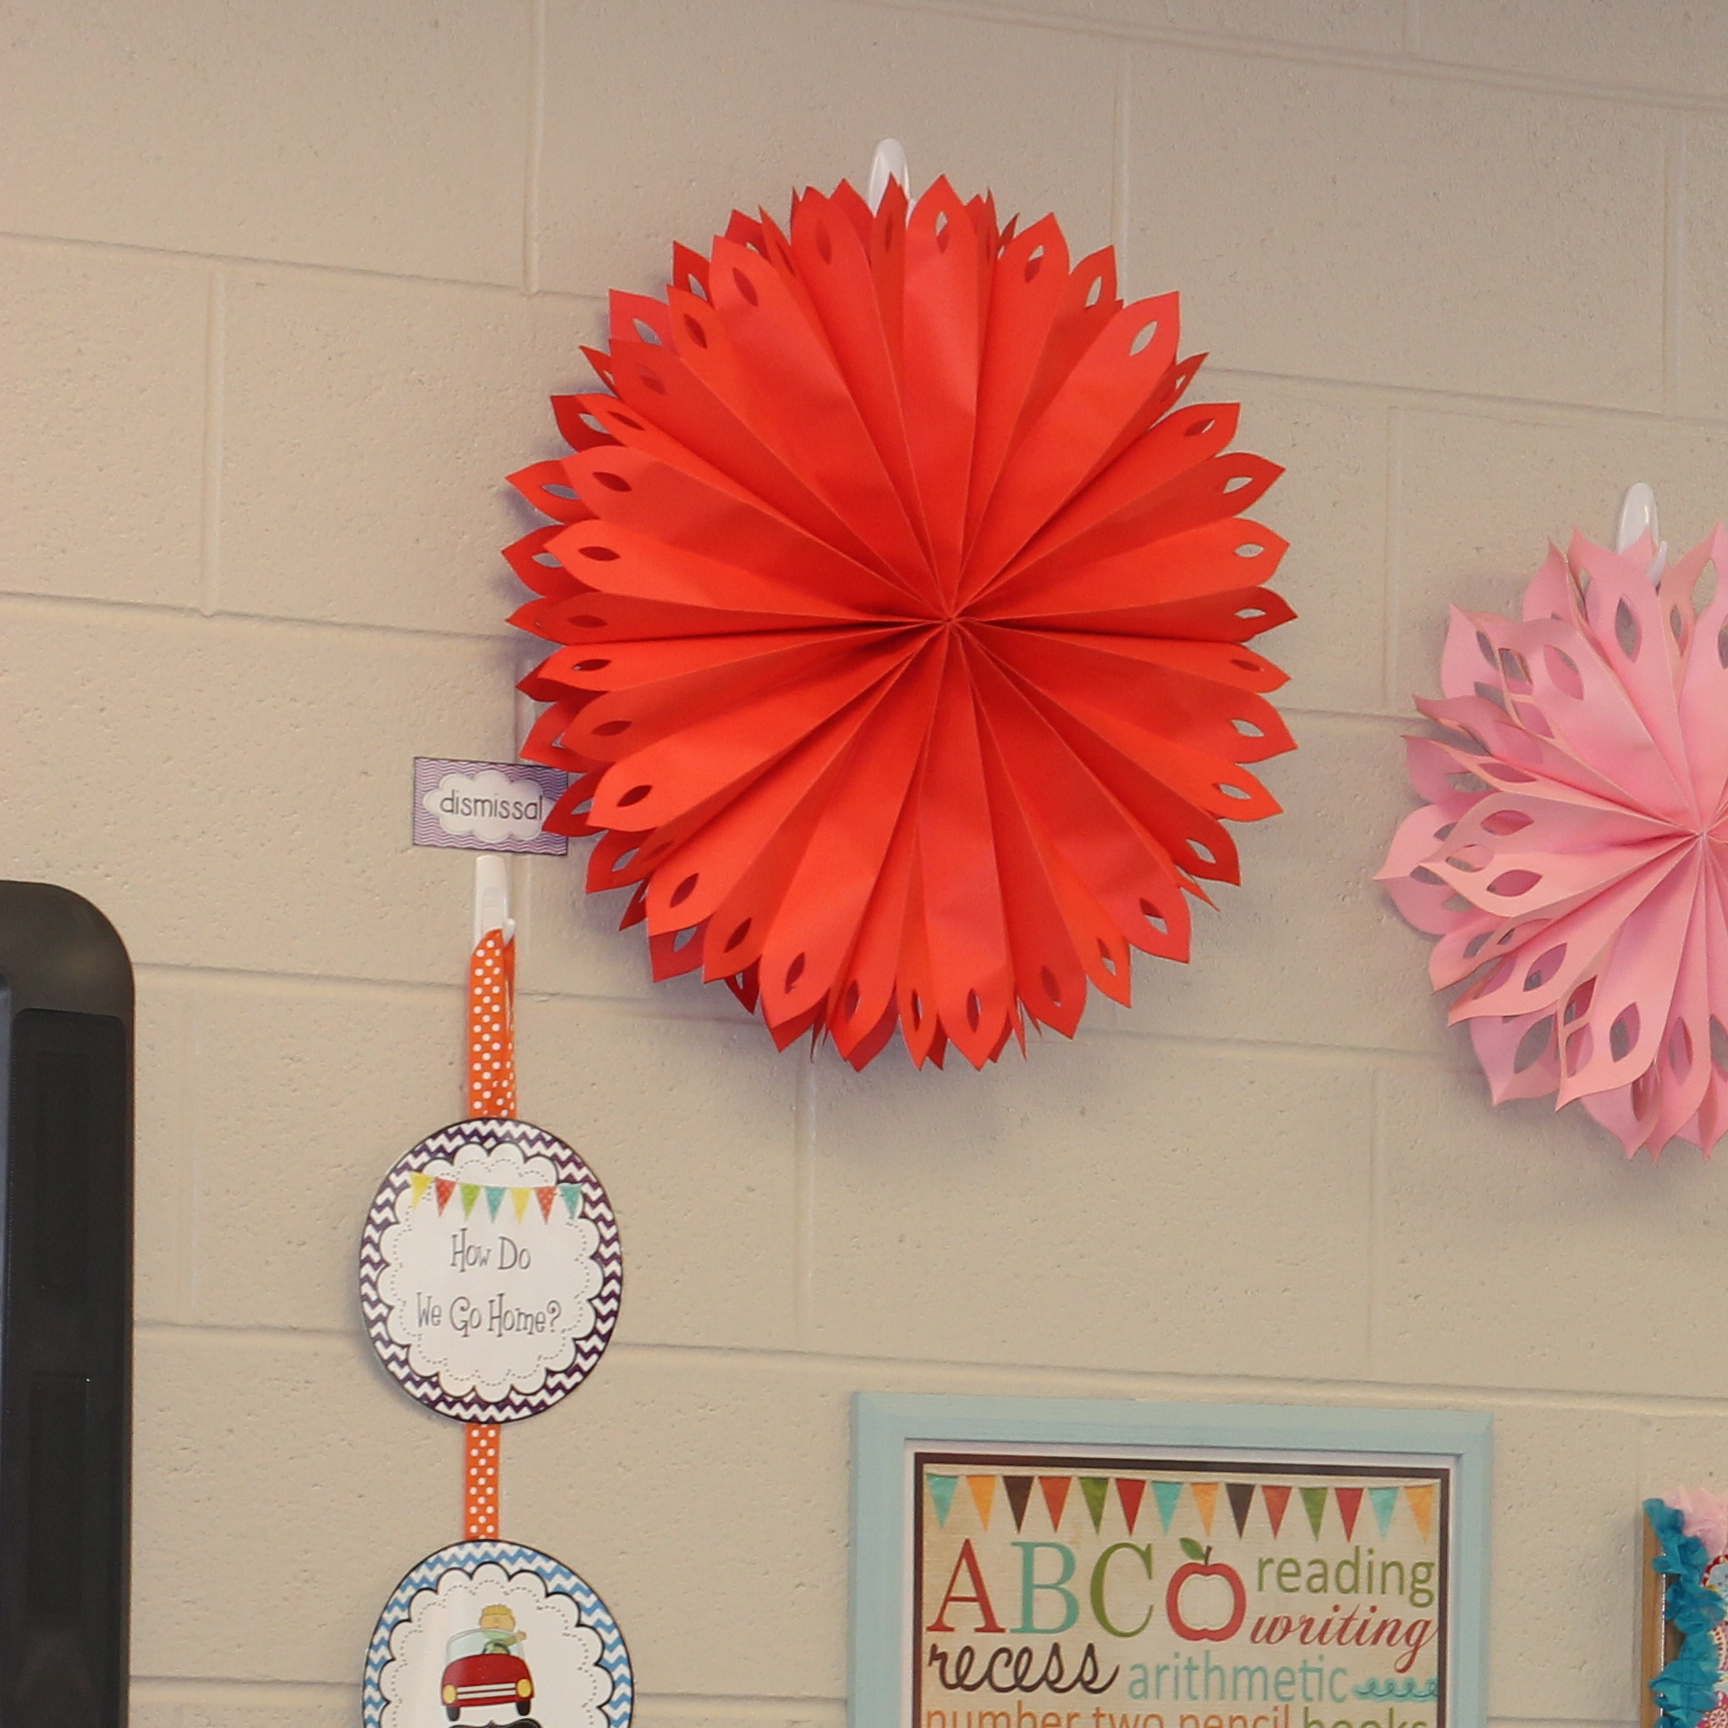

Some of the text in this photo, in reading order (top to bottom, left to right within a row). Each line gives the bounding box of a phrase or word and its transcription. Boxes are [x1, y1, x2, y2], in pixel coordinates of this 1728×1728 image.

[440, 787, 543, 821] dismissal
[451, 1228, 531, 1272] How Do
[415, 1291, 563, 1338] We Go Home?
[1256, 1545, 1436, 1608] reading
[1250, 1603, 1439, 1674] writing
[928, 1642, 1349, 1704] recess arithmetic
